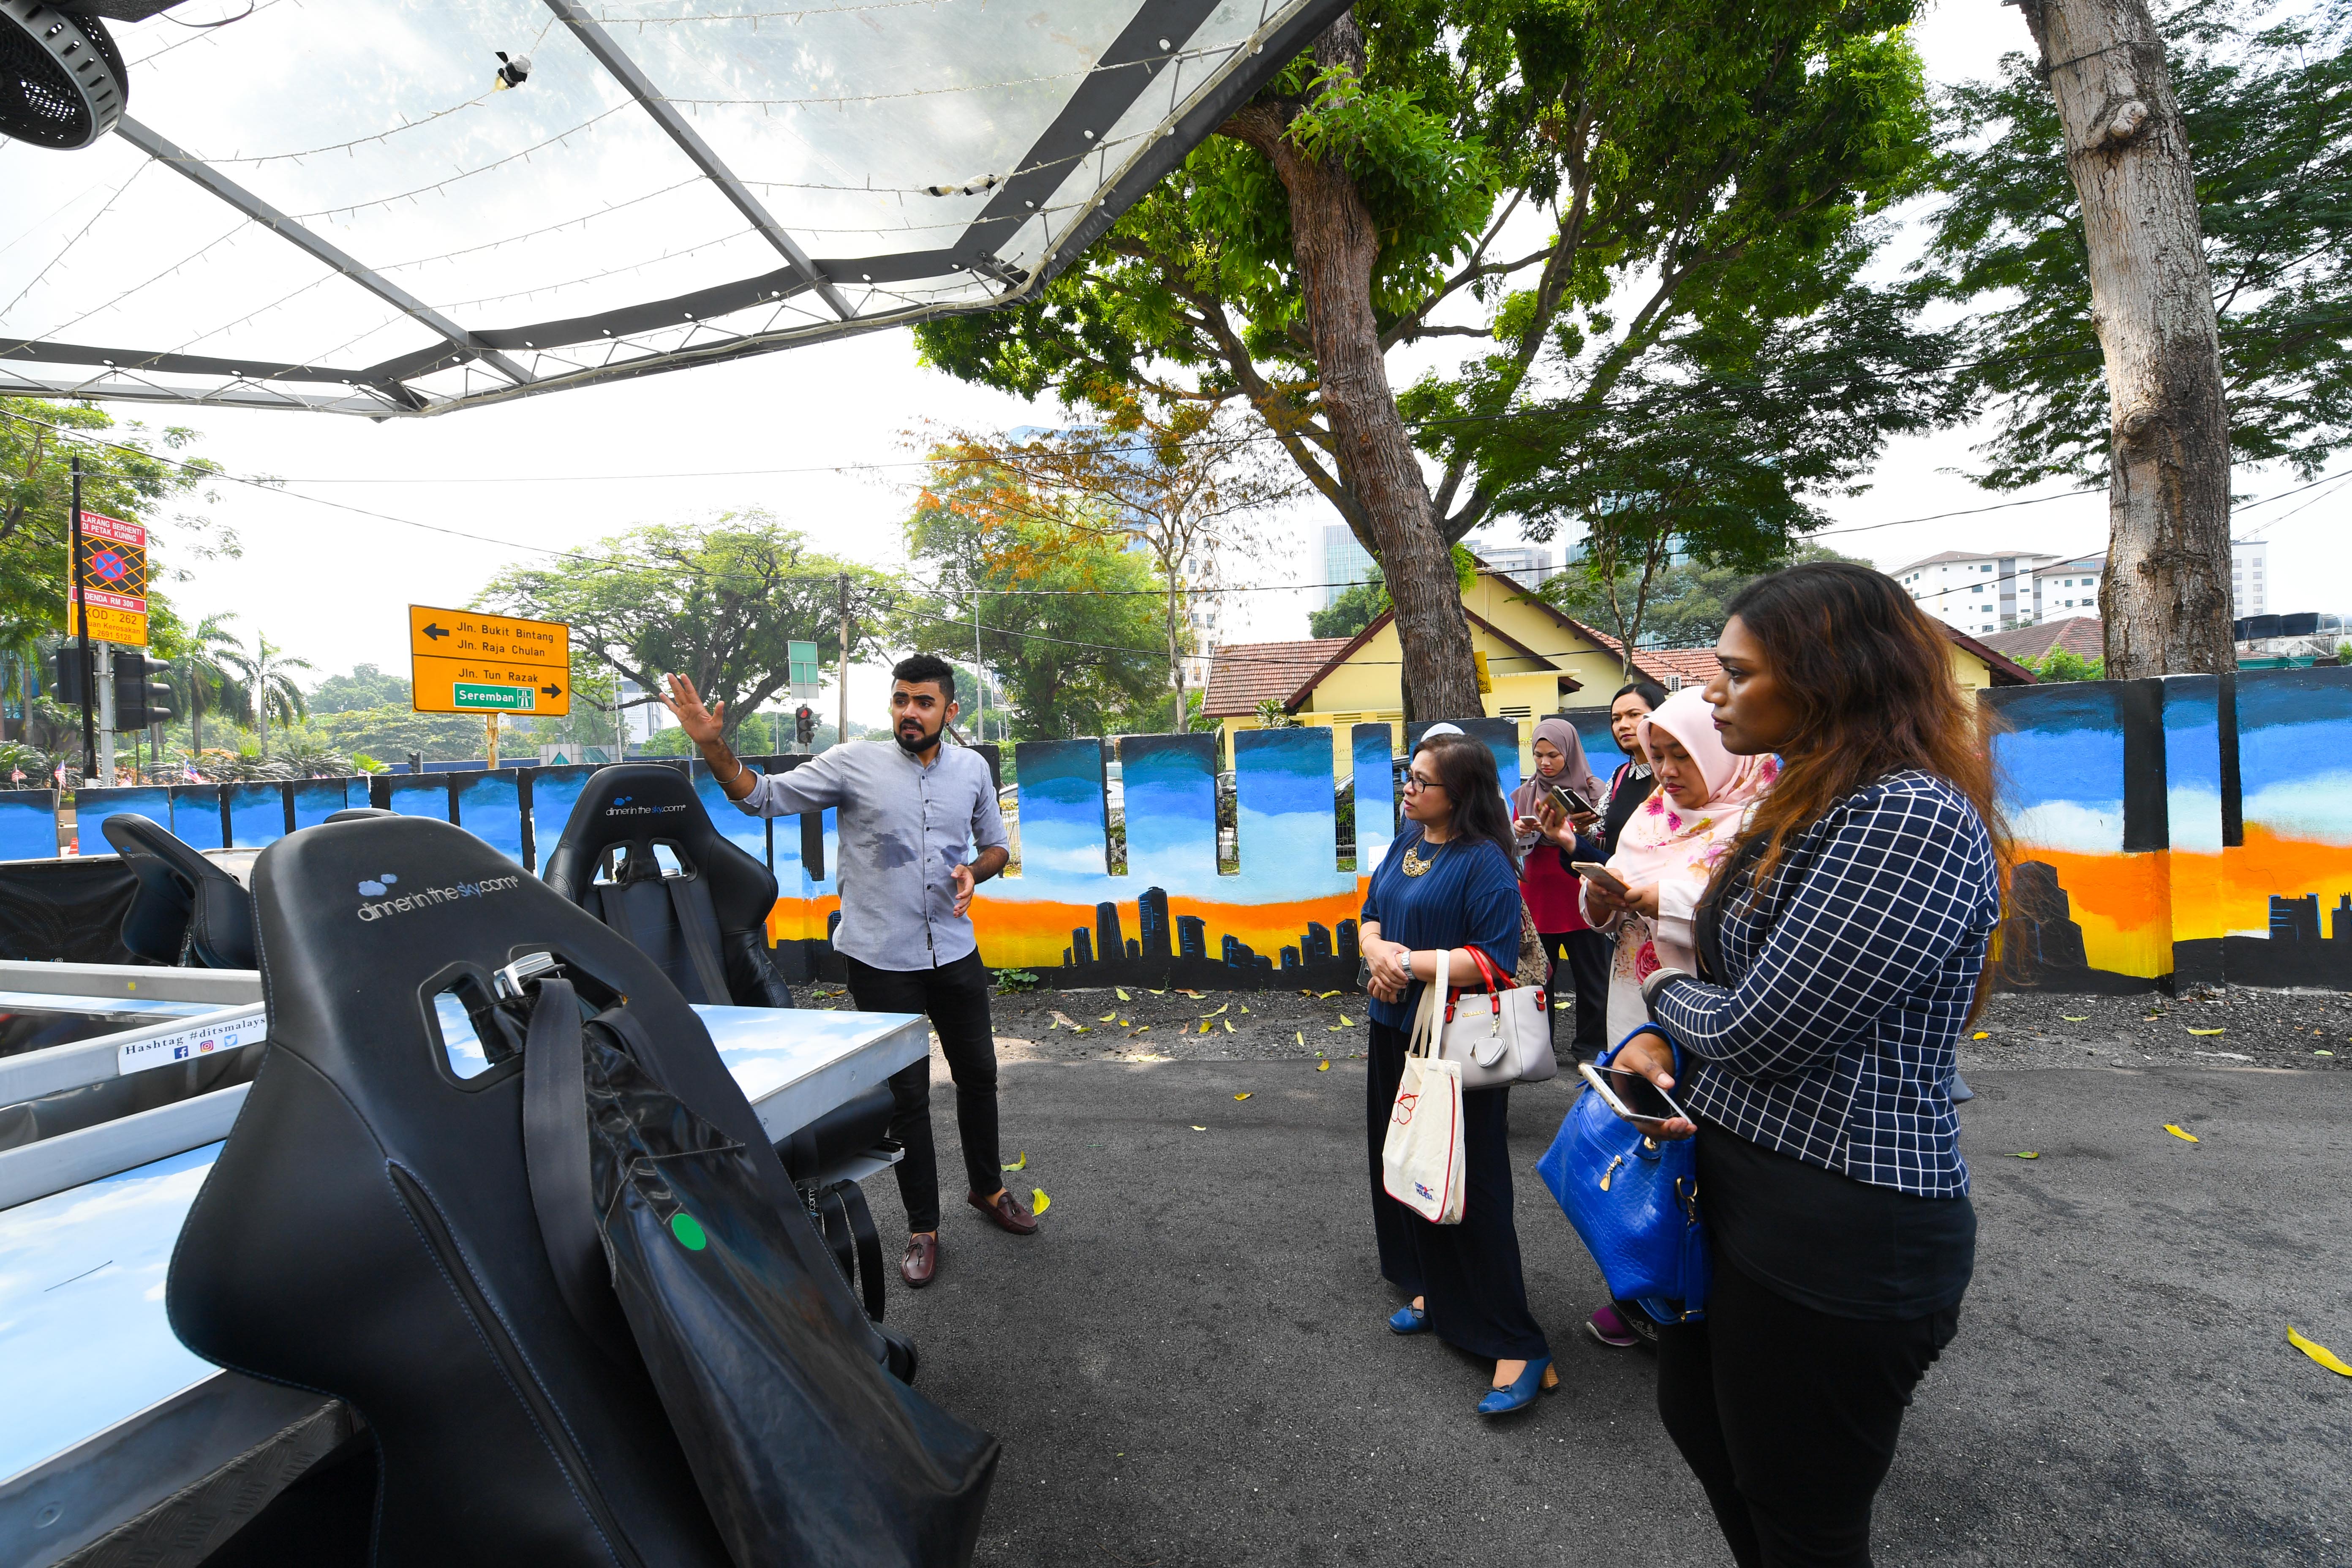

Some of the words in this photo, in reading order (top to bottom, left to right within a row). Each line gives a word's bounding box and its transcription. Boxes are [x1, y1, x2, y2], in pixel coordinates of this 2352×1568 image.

[81, 514, 110, 528] ILARANG
[112, 522, 142, 536] BERHENTI
[82, 523, 89, 531] DI
[91, 525, 112, 536] PETAK
[114, 531, 137, 542] KUNING
[85, 592, 108, 603] DENDA
[110, 596, 121, 605] RM
[122, 600, 134, 608] 300
[86, 608, 108, 620] KOD
[119, 613, 137, 625] 262
[97, 630, 113, 638] 2691
[103, 622, 141, 634] Kerosakan
[457, 622, 476, 633] Jln.
[482, 625, 509, 636] Bukit
[516, 629, 554, 643] Bintang
[457, 640, 477, 650] Jln.
[482, 642, 505, 654] Raja
[512, 645, 545, 656] Chulan
[458, 668, 478, 678] Jln.
[483, 670, 501, 680] Tun
[508, 672, 538, 683] Razak
[459, 690, 514, 702] Seremban
[125, 1036, 184, 1055] Hashtag
